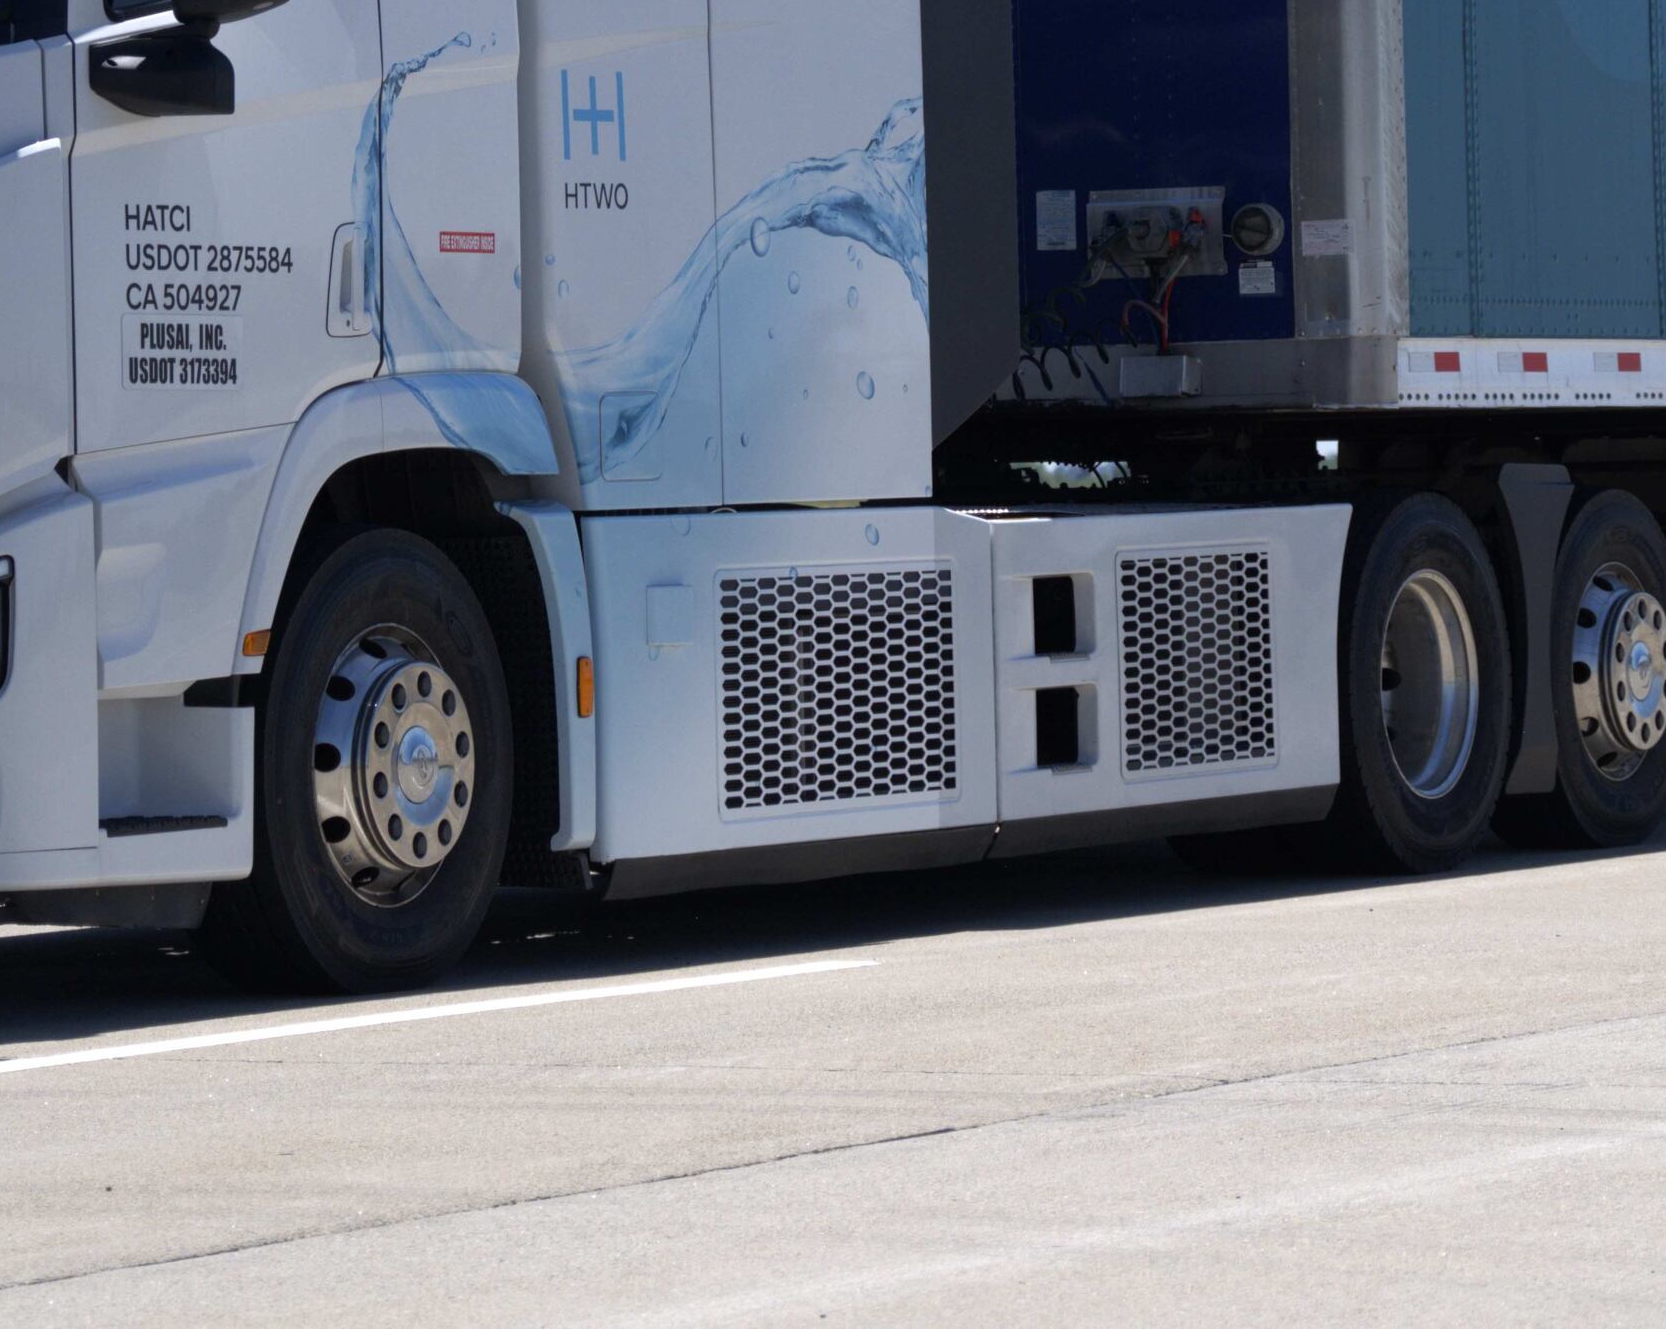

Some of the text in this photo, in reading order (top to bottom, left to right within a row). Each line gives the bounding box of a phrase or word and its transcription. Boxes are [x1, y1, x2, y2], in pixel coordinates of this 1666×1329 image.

[564, 182, 629, 210] HTWO
[124, 203, 191, 232] HATCI
[125, 243, 293, 273] USDOT 2875584
[126, 282, 242, 311] CA 504927
[139, 322, 227, 353] PLUSAI, INC.
[129, 357, 237, 385] USDOT 3173394
